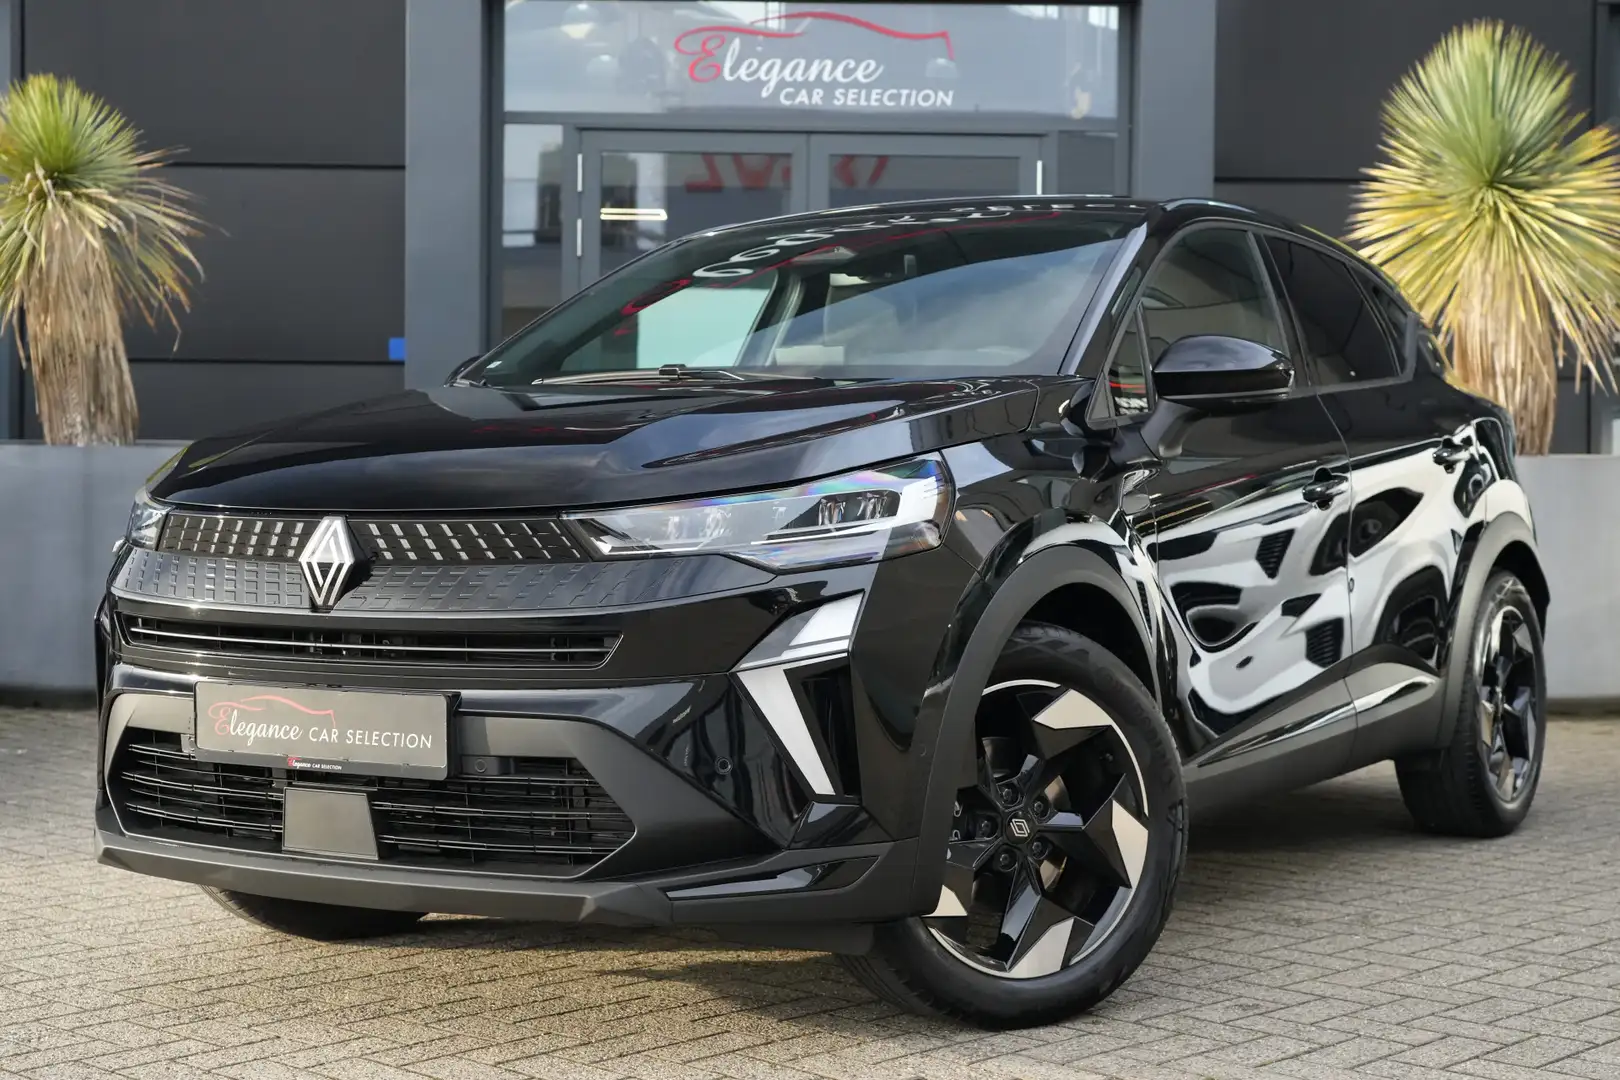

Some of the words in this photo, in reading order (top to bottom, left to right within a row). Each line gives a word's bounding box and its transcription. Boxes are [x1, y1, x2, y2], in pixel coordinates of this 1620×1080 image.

[674, 31, 884, 98] Elegance
[779, 88, 824, 105] CAR
[833, 88, 954, 107] SELECTION
[207, 704, 303, 746] Elegance
[308, 727, 338, 743] CAR
[345, 730, 432, 749] SELECTION
